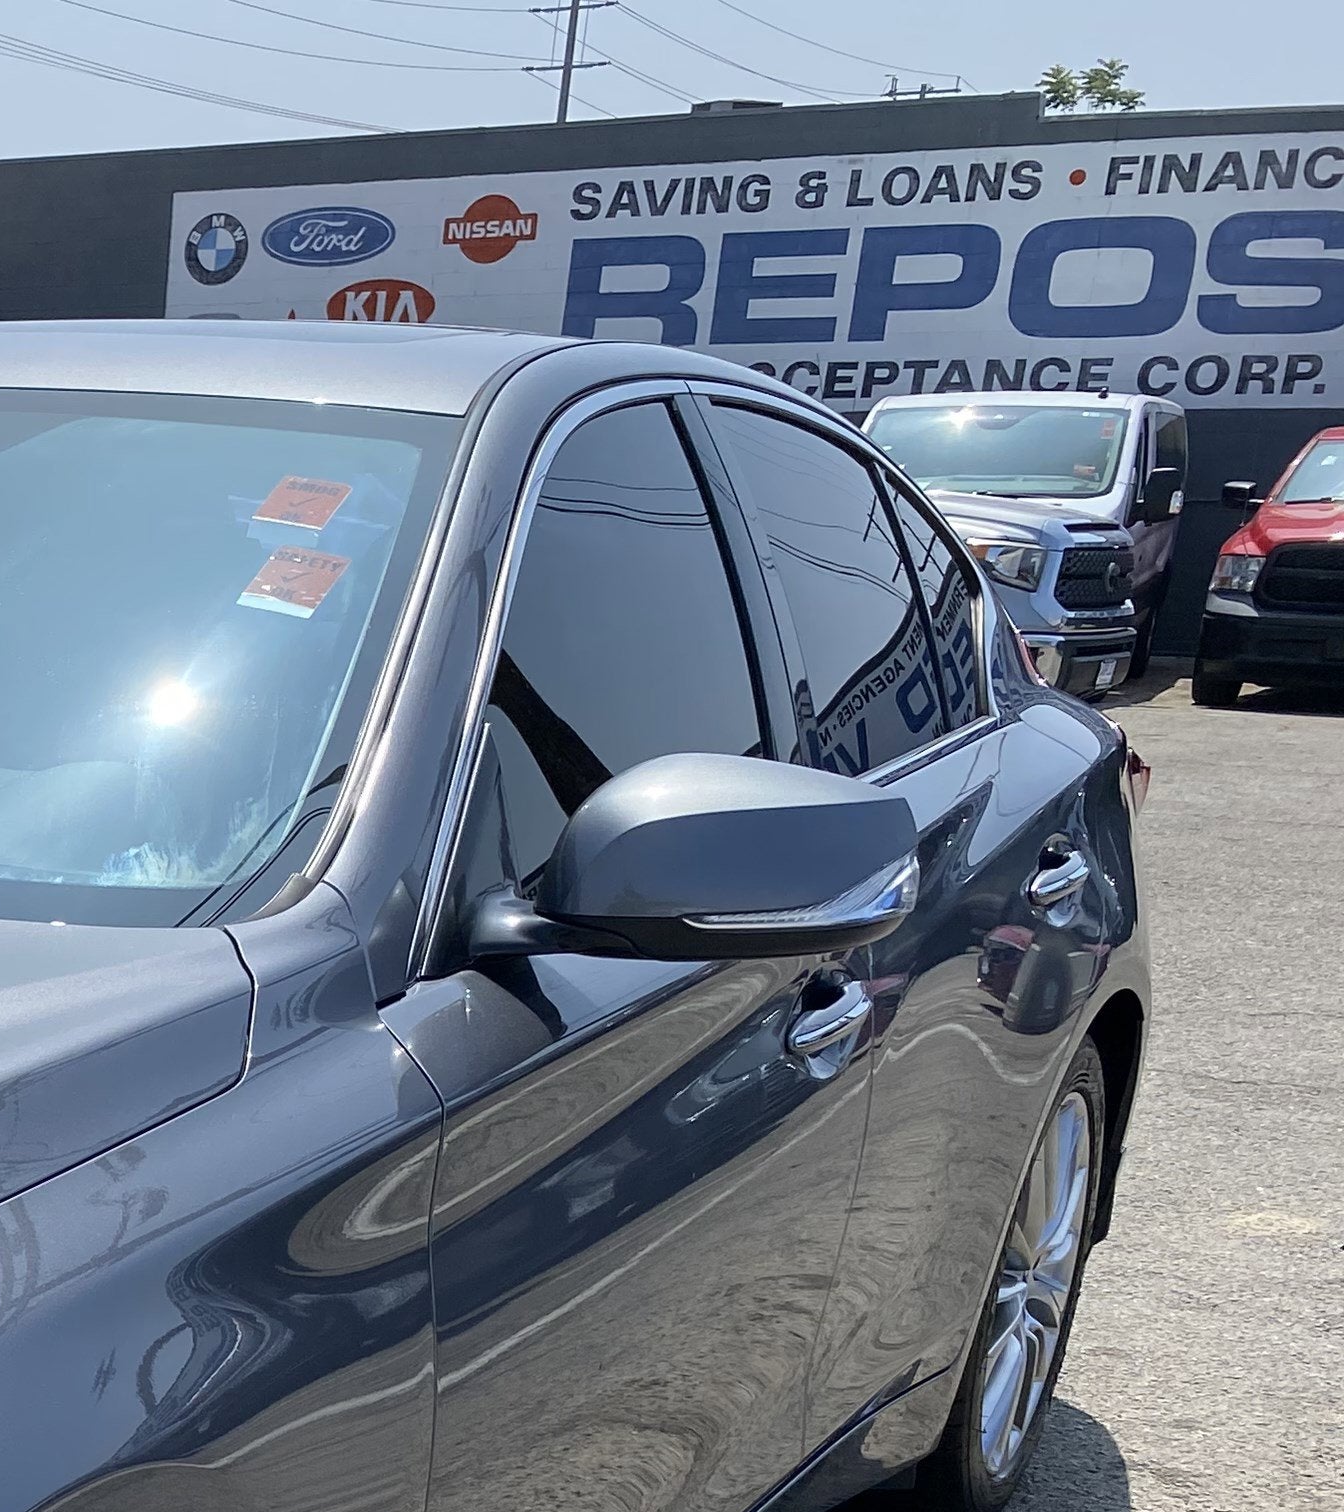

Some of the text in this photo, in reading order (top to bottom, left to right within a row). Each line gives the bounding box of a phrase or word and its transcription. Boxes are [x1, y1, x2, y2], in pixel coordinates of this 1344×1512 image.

[570, 146, 1344, 220] SAVING & LOANS FINANC
[290, 218, 366, 254] Ford
[448, 217, 532, 241] NISSAN
[561, 210, 1344, 345] REPOS
[344, 290, 418, 323] KIA
[1136, 353, 1326, 397] CORP.
